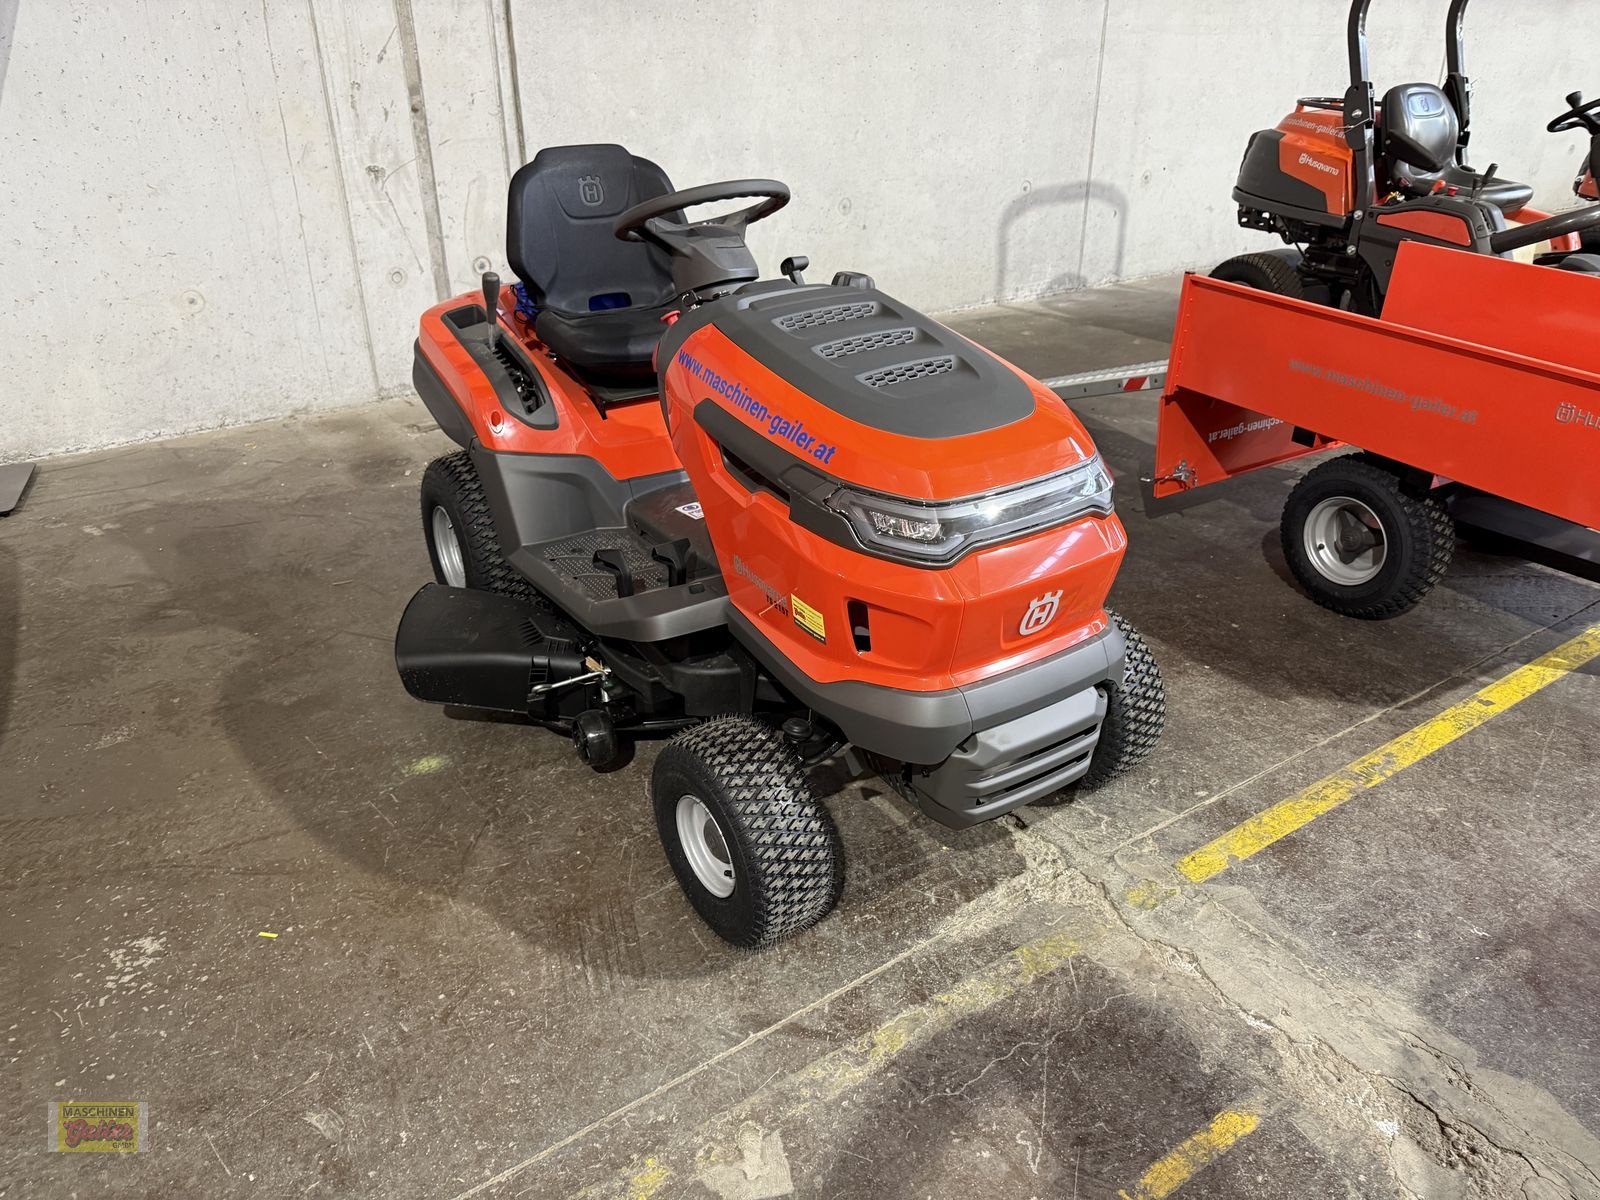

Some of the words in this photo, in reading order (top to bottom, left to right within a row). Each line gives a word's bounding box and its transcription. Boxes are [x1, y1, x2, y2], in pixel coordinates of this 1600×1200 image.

[1305, 155, 1340, 176] Husqvarna
[678, 349, 836, 465] www.maschinen-gailer.at
[1288, 358, 1479, 426] www.maschinen-gailer.at
[1575, 408, 1600, 430] Hu
